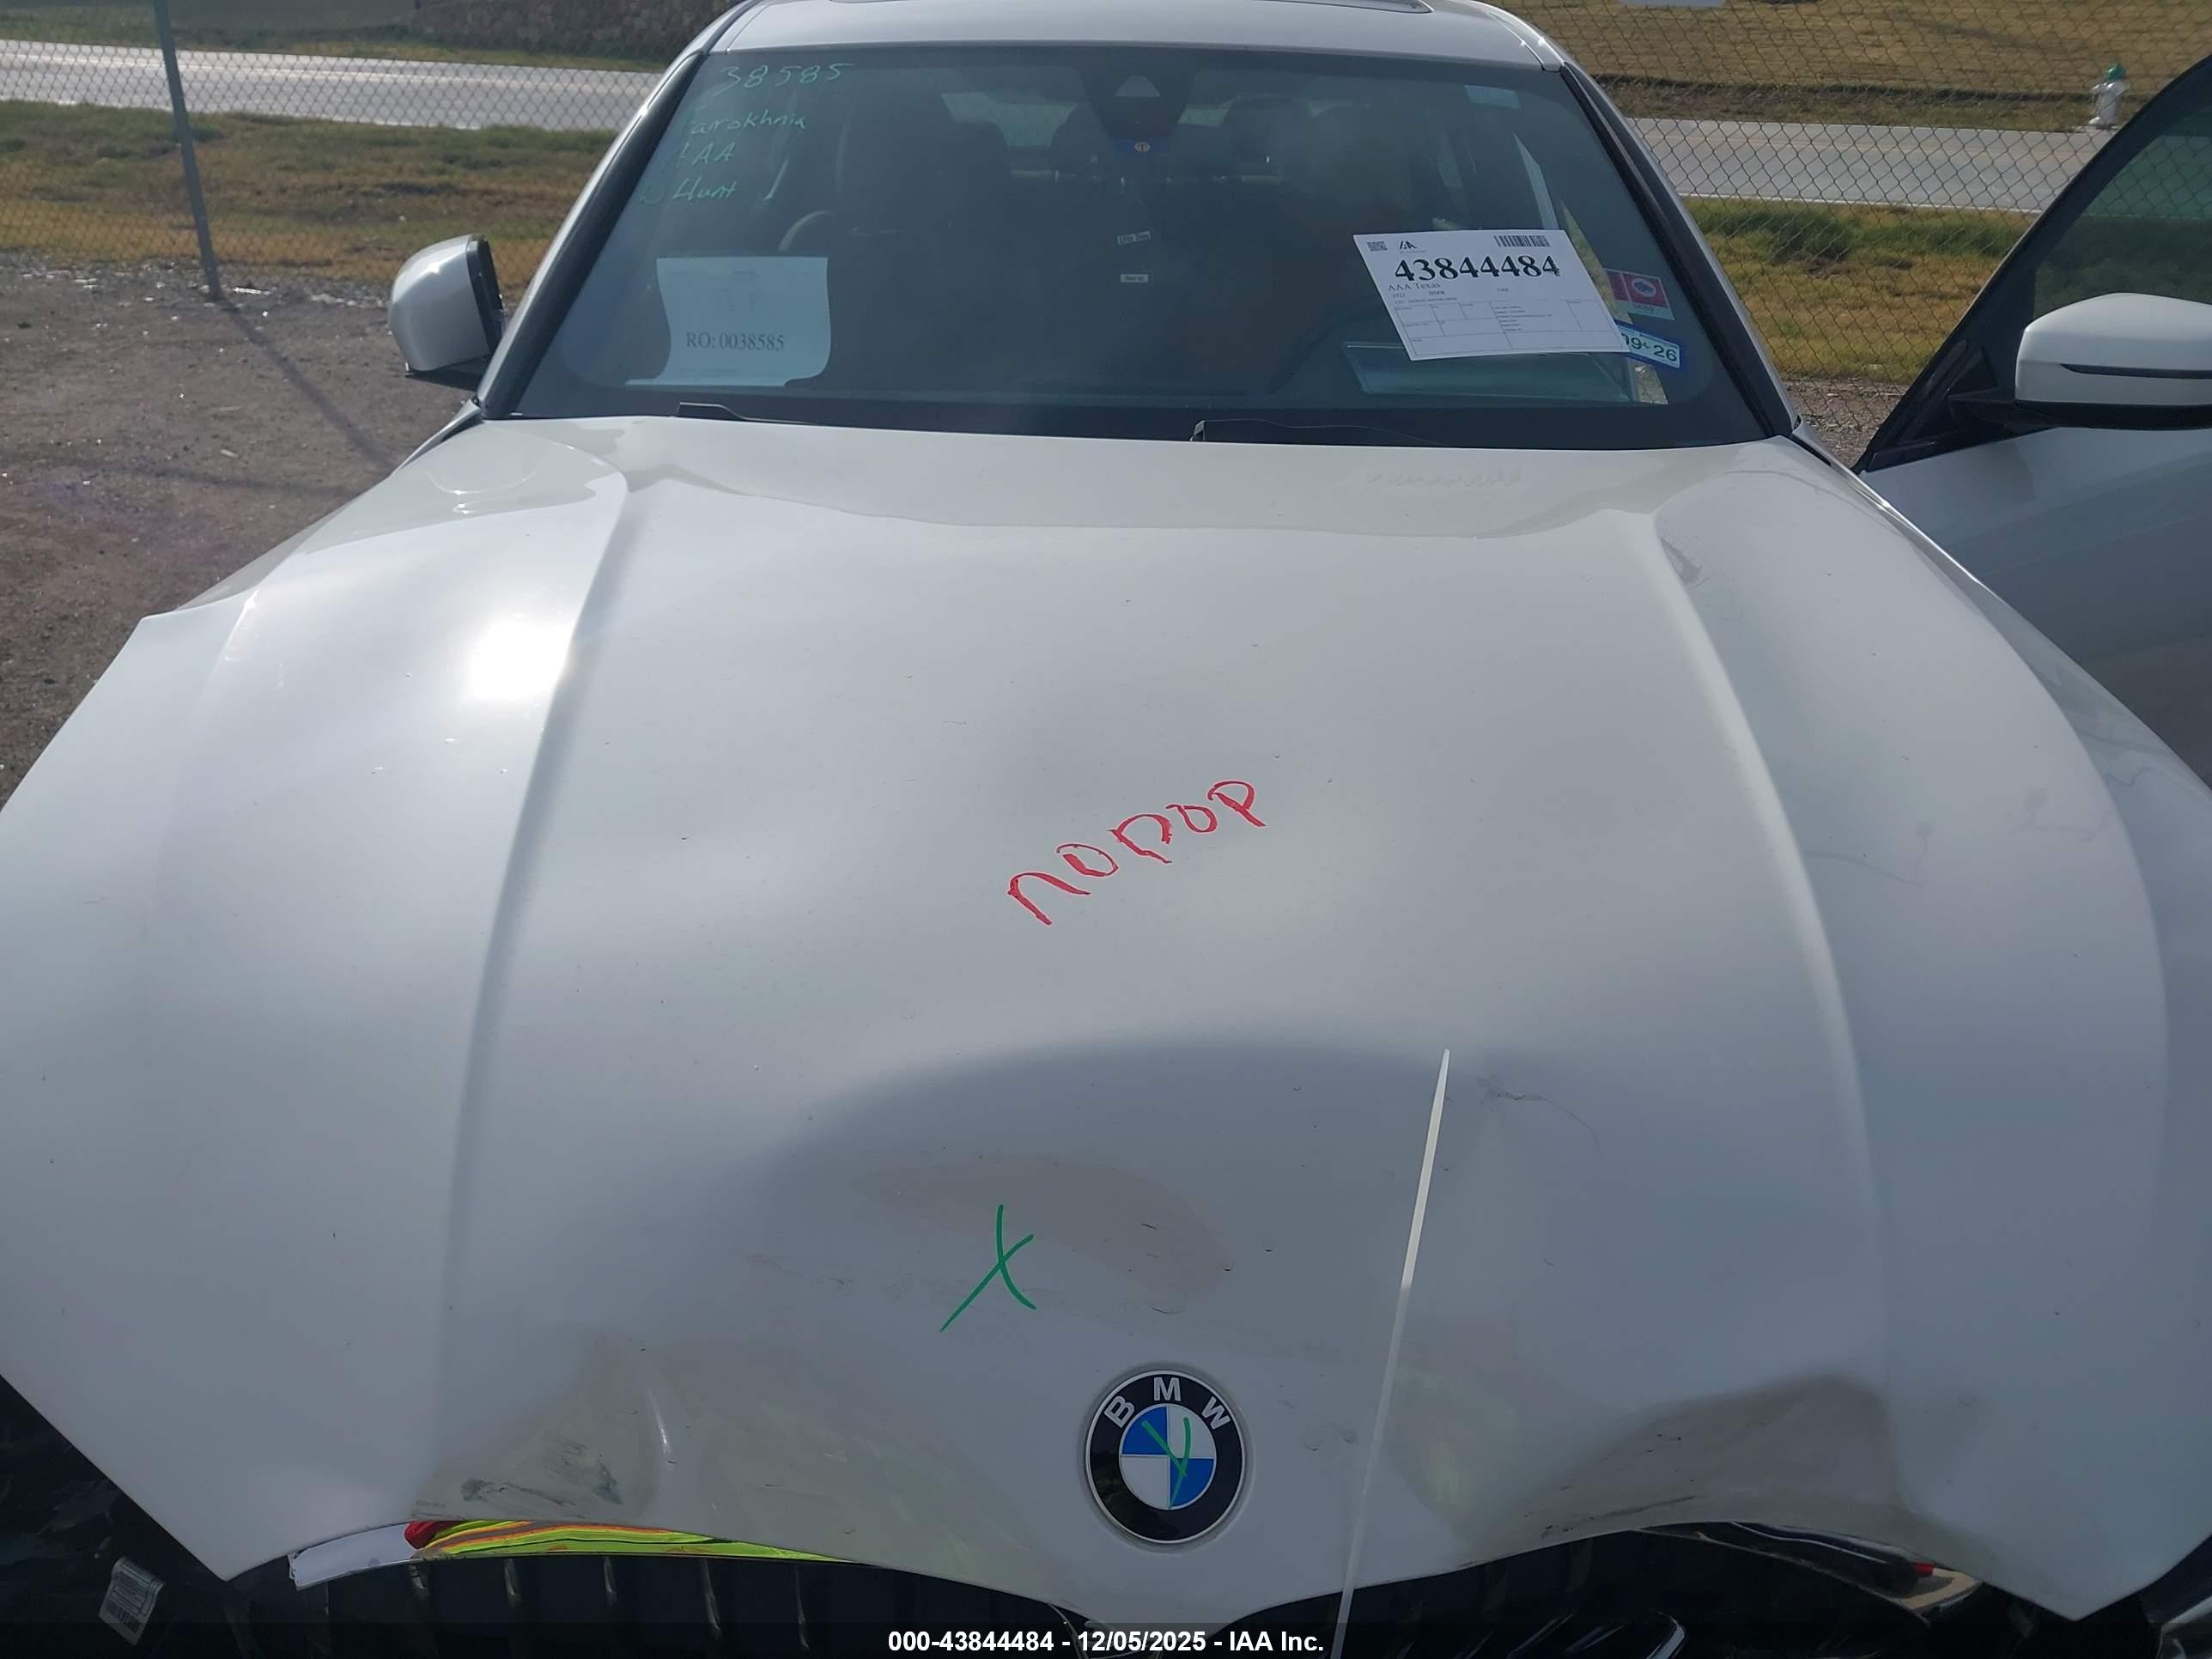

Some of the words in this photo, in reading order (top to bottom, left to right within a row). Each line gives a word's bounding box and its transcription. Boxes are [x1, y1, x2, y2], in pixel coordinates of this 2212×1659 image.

[1395, 255, 1560, 282] 43844484
[1388, 283, 1412, 292] AAA
[1415, 282, 1441, 290] Texas
[686, 331, 716, 349] RO:
[719, 332, 785, 351] 0038585
[1653, 343, 1678, 362] 26
[1104, 1376, 1231, 1430] BMW
